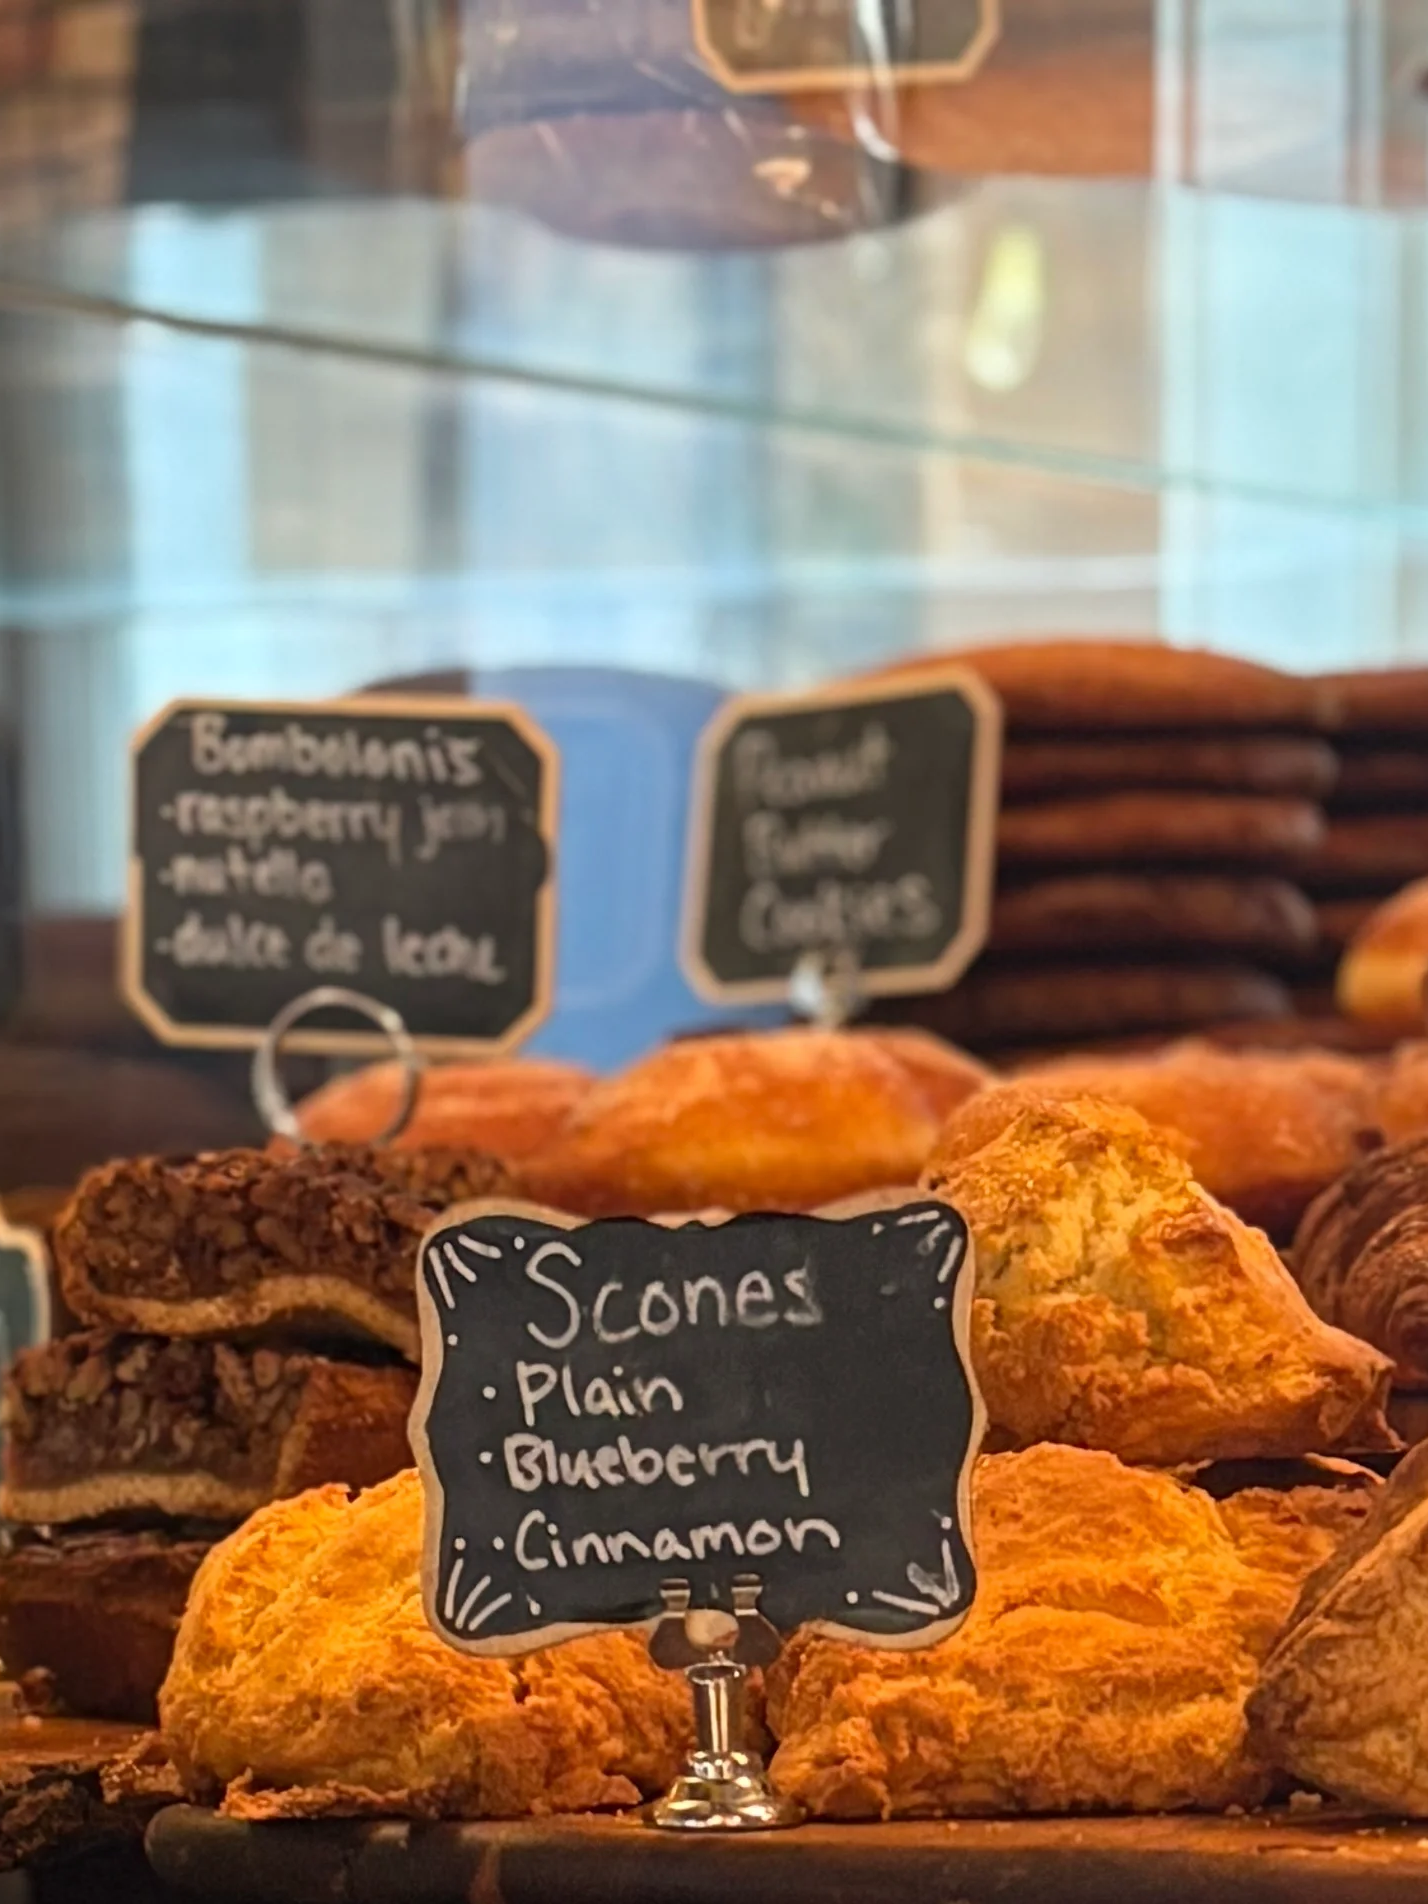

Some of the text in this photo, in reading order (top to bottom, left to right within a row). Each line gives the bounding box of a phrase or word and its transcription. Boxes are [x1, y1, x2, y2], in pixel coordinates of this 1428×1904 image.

[304, 915, 364, 973] de
[524, 1242, 822, 1348] Scones
[515, 1361, 684, 1426] Plain
[503, 1433, 811, 1498] Blueberry
[514, 1508, 842, 1573] Cinnamon
